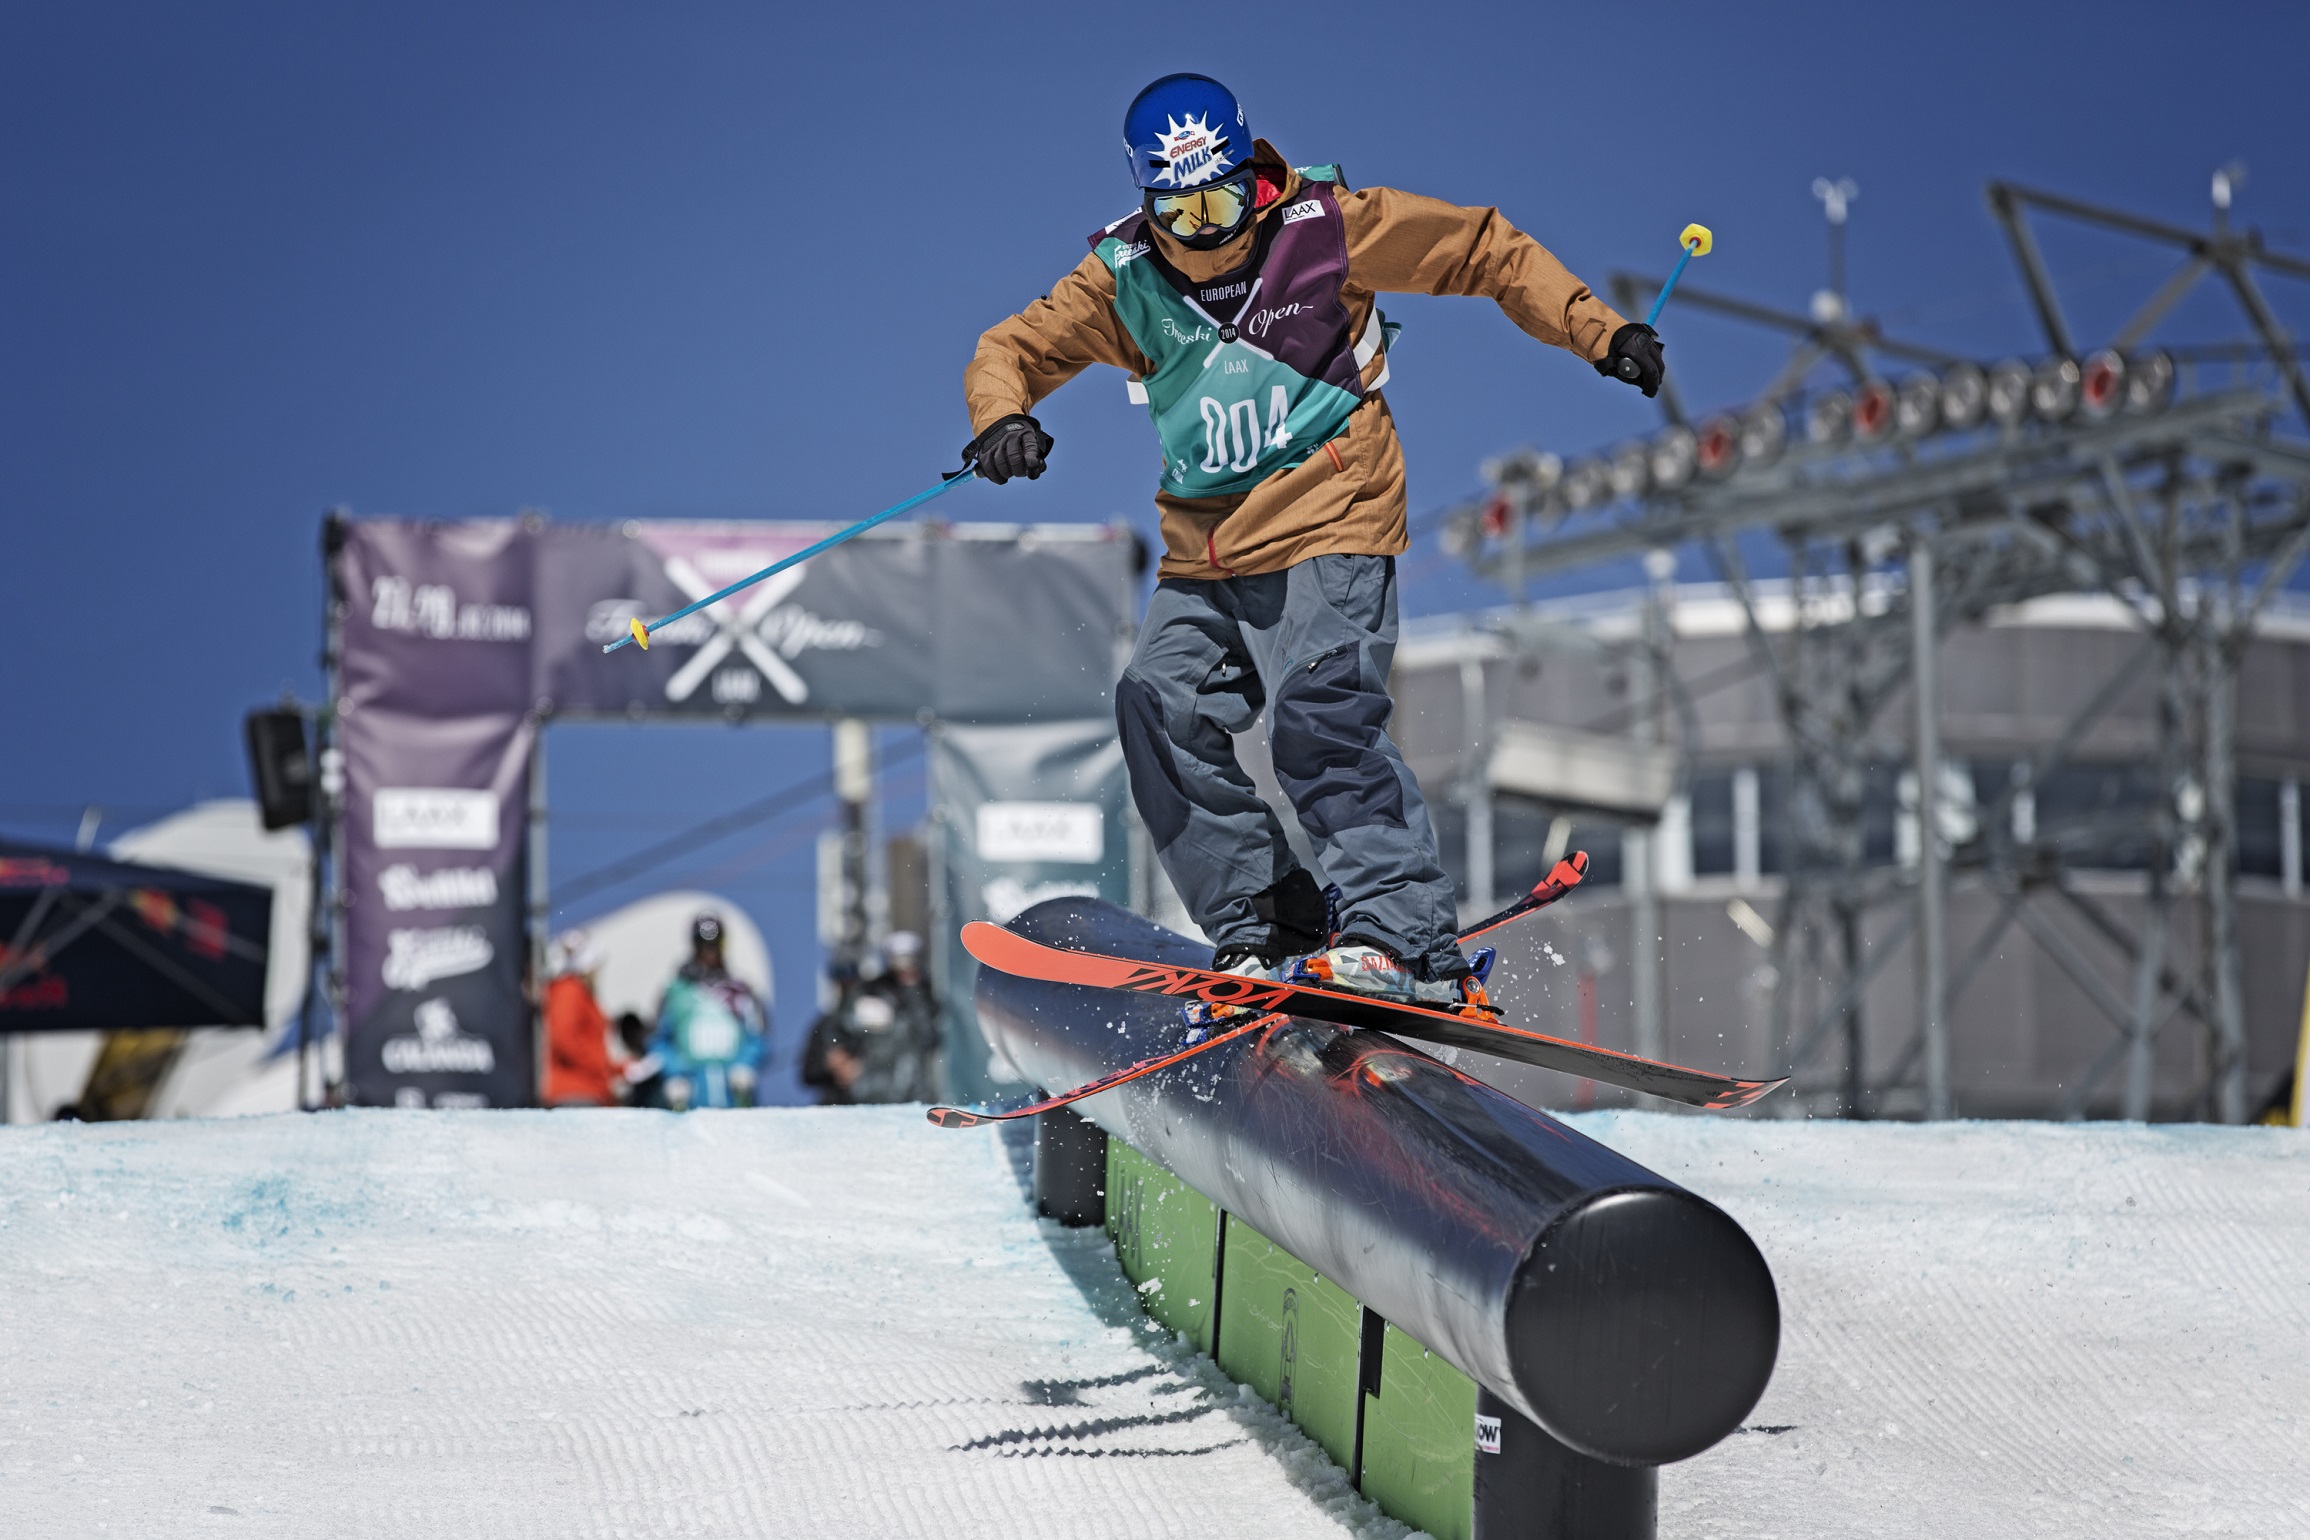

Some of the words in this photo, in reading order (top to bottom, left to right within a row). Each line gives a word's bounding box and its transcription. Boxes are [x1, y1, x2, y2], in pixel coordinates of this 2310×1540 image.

[1169, 136, 1206, 158] ENERGY
[1174, 145, 1212, 181] MILK
[1284, 202, 1316, 219] LAAX
[1201, 281, 1247, 302] EUROPEAN
[1220, 327, 1237, 340] 2014
[1248, 302, 1314, 338] Open
[1224, 358, 1249, 375] LAAX
[1200, 385, 1293, 473] 004
